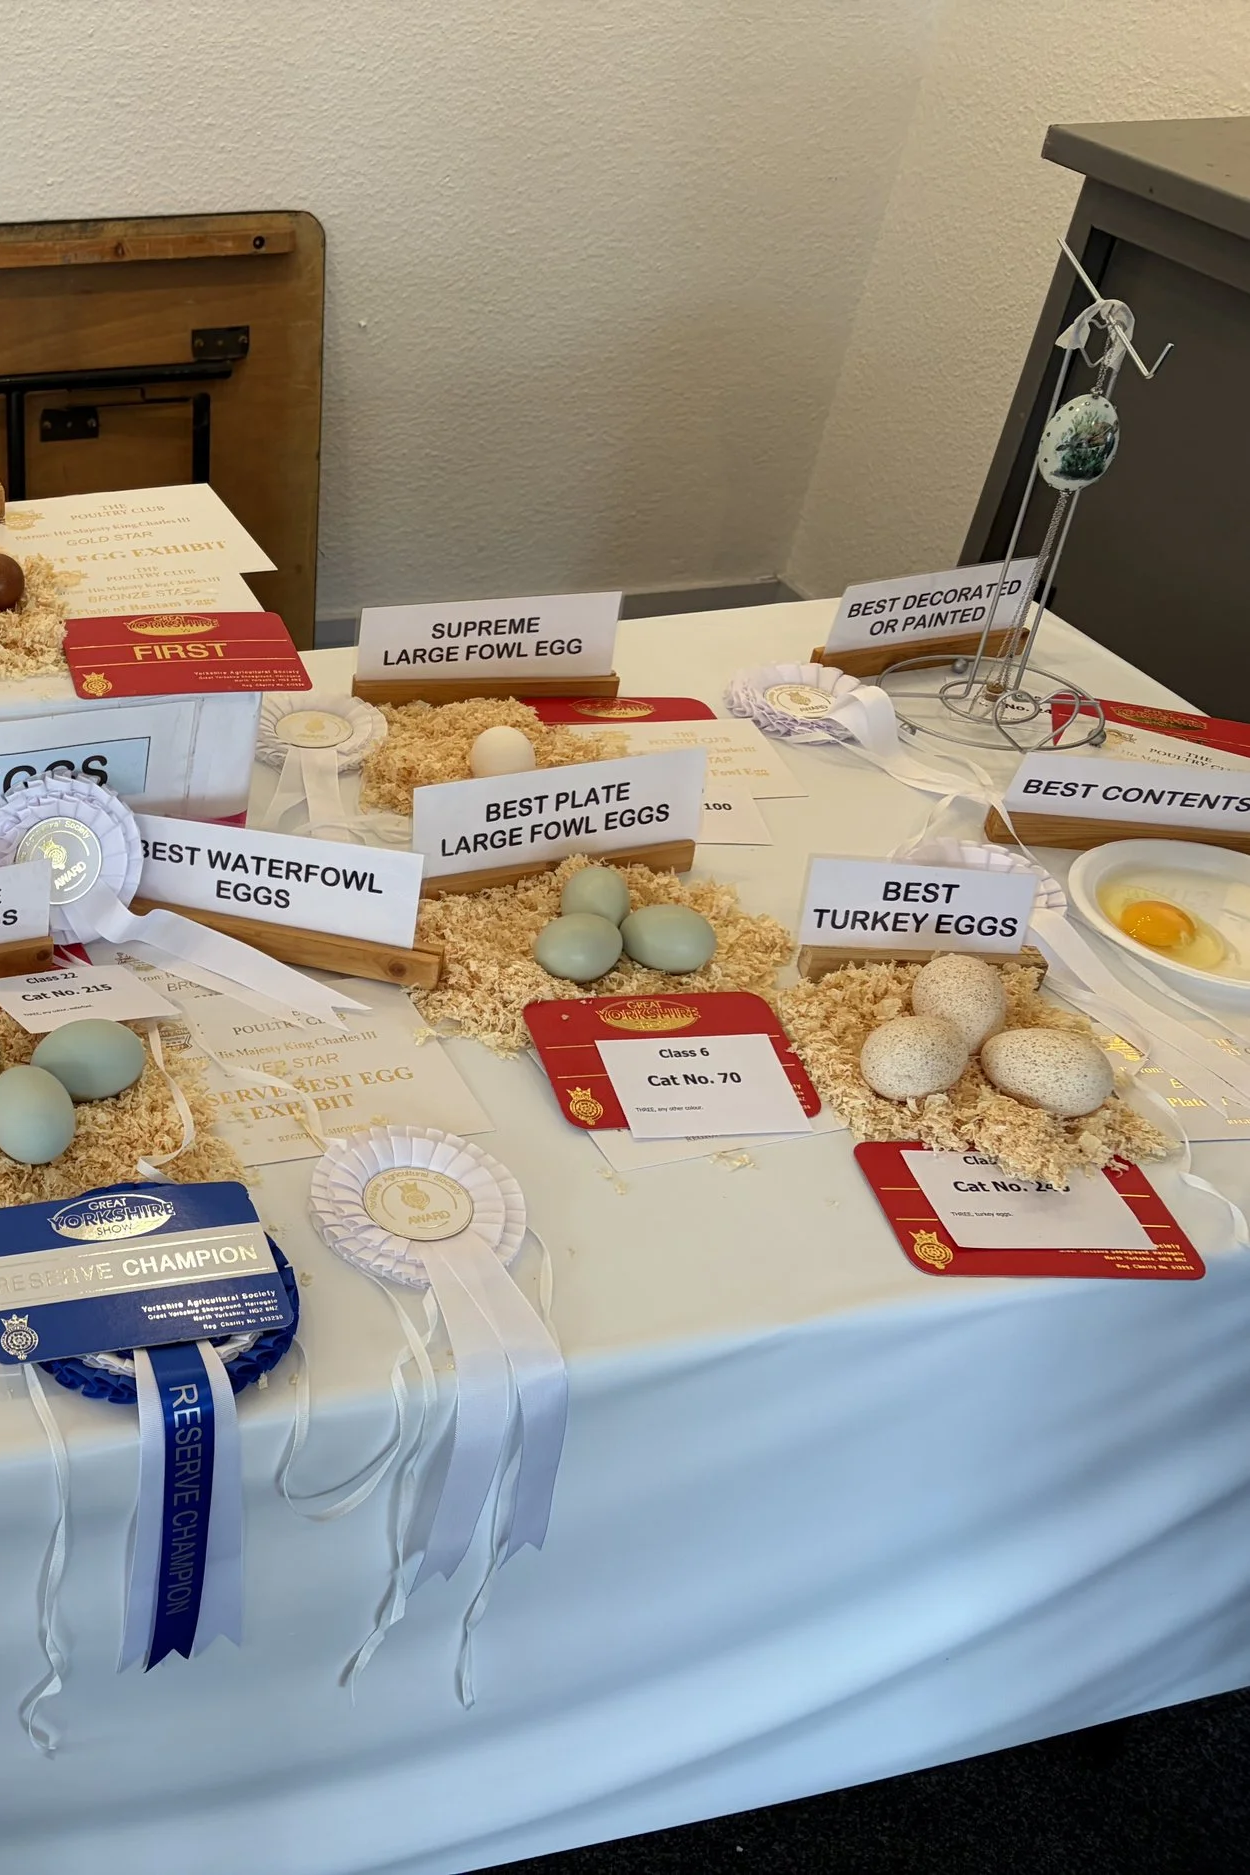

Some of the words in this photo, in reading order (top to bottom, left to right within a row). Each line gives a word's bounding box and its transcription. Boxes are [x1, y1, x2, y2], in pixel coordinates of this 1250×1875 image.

[70, 509, 130, 521] POULTRY
[132, 505, 166, 514] CLUB
[67, 536, 109, 546] GOLD
[114, 531, 153, 542] STAR
[132, 540, 227, 558] EXHIBIT
[848, 597, 900, 618] BEST
[903, 579, 1021, 610] DECORATED
[432, 617, 540, 639] SUPREME
[870, 618, 898, 636] OR
[902, 606, 986, 631] PAINTED
[133, 643, 227, 661] FIRST
[383, 646, 459, 665] LARGE
[466, 643, 528, 660] FOWL
[535, 638, 582, 656] EGG
[486, 795, 548, 822] BEST
[555, 782, 631, 811] PLATE
[705, 802, 732, 811] 100
[1023, 779, 1098, 798] BEST
[1102, 785, 1250, 813] CONTENTS
[65, 820, 90, 839] Society
[441, 827, 522, 857] LARGE
[530, 816, 597, 843] FOWL
[604, 803, 669, 830] EGGS
[54, 861, 86, 889] AWARD
[207, 849, 383, 894] WATERFOWL
[216, 880, 290, 909] EGGS
[882, 882, 960, 904] BEST
[813, 909, 929, 933] TURKEY
[935, 914, 1018, 937] EGGS
[26, 975, 59, 984] Class
[22, 992, 50, 1001] Cat
[81, 984, 112, 993] 215
[595, 1007, 701, 1022] YORKSHIRE
[627, 1001, 662, 1009] GREAT
[236, 1045, 280, 1061] Majesty
[284, 1039, 314, 1050] King
[315, 1033, 360, 1045] Charles
[361, 1031, 377, 1040] III
[659, 1049, 697, 1058] Class
[700, 1048, 710, 1056] 6
[292, 1052, 340, 1068] STAR
[207, 1085, 288, 1106] SERVE
[359, 1067, 413, 1085] EGG
[648, 1075, 680, 1086] Cat
[682, 1073, 714, 1085] No.
[717, 1072, 742, 1083] 70
[251, 1092, 355, 1120] EXHBIT
[382, 1170, 429, 1183] Agricultural
[433, 1174, 463, 1195] Society
[953, 1181, 990, 1192] Cat
[991, 1181, 1028, 1192] No.
[88, 1198, 126, 1210] GREAT
[47, 1201, 176, 1230] YORKSHIRE
[408, 1210, 451, 1225] AWARD
[96, 1224, 132, 1236] SHOW
[122, 1244, 258, 1277] CHAMPION
[141, 1302, 184, 1313] Yorkshire
[187, 1294, 239, 1308] Agricultural
[242, 1290, 276, 1300] Society
[169, 1309, 199, 1318] Yorkshire
[221, 1320, 245, 1328] Charity
[169, 1383, 202, 1506] RESERVE
[166, 1510, 199, 1616] CHAMPION
